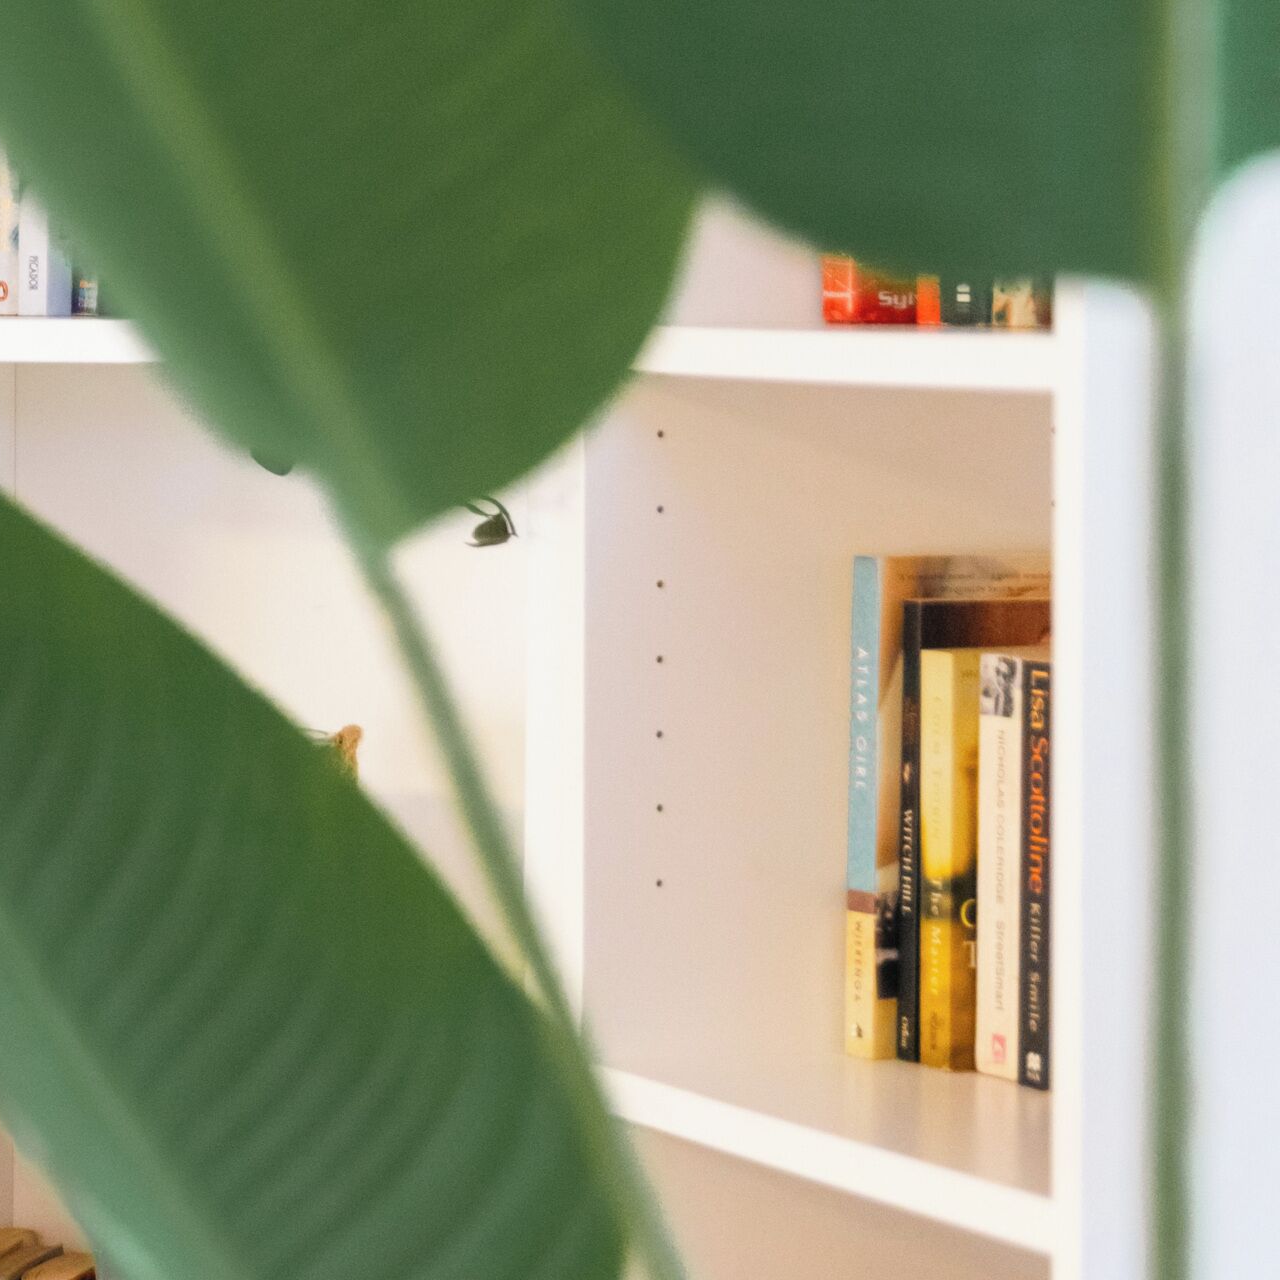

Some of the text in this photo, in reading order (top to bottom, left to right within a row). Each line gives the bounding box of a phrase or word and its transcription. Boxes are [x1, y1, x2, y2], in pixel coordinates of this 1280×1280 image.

[28, 255, 40, 291] PICADOR
[855, 646, 869, 789] ATLAS GIRL
[995, 728, 1006, 809] NICHOLAS
[1029, 669, 1050, 894] Lisa Scottoline
[901, 808, 914, 872] WITCH
[995, 815, 1006, 905] COLERIDGE
[853, 920, 864, 1002] WIERENGA
[929, 877, 943, 996] The Master
[1028, 902, 1042, 1033] Killer Smile
